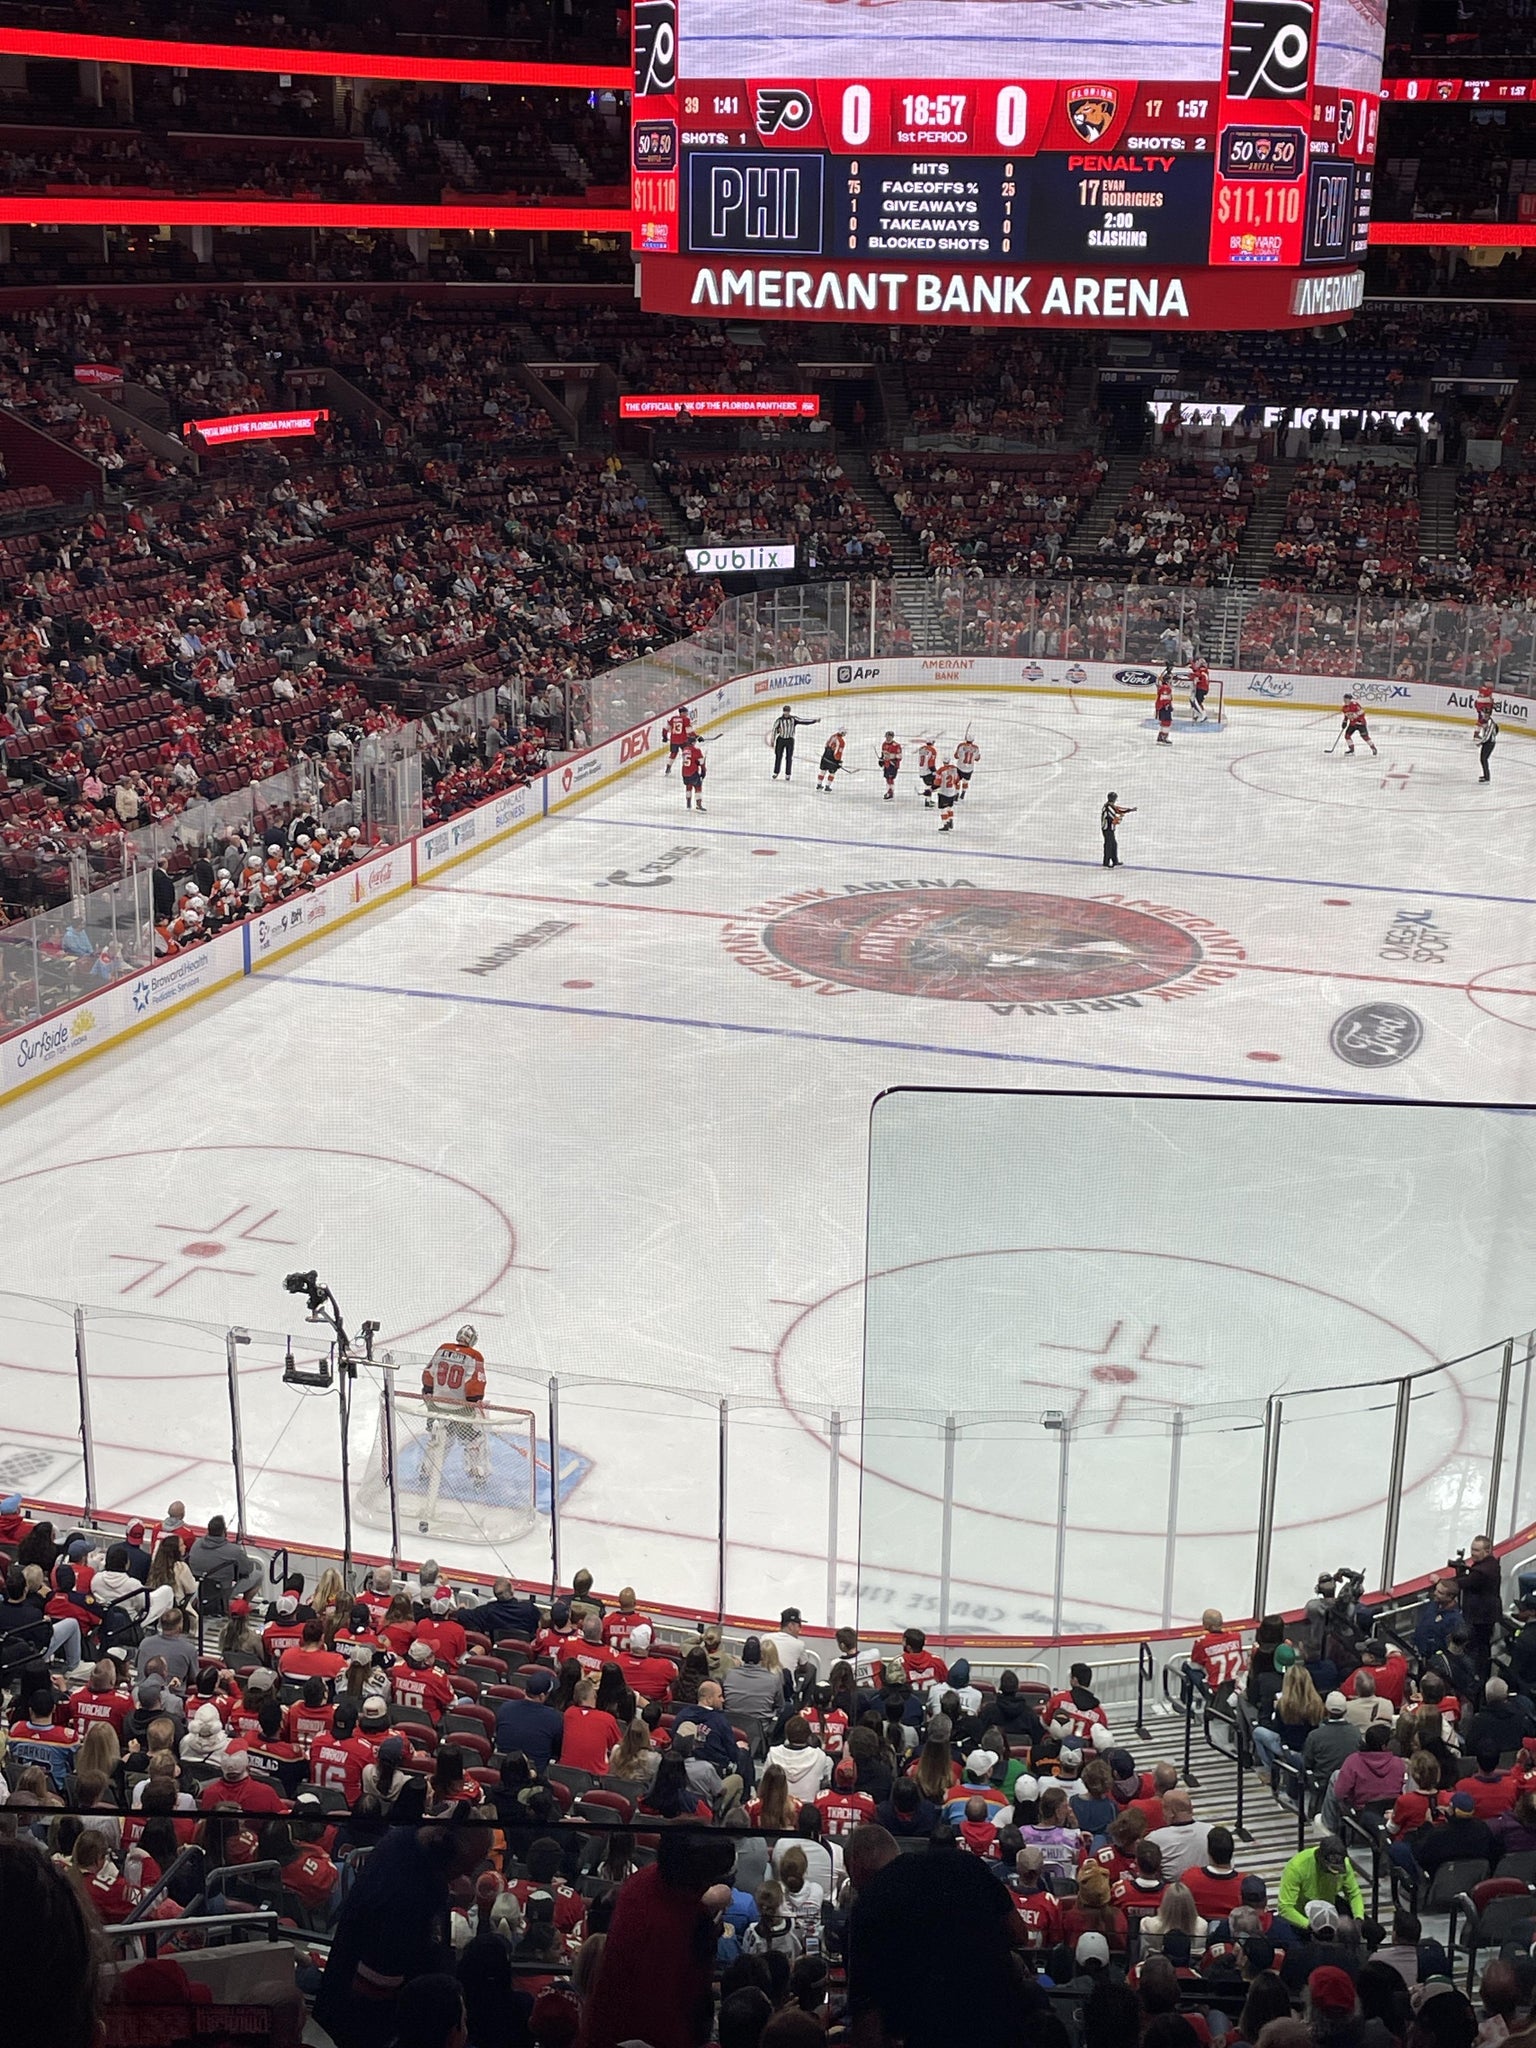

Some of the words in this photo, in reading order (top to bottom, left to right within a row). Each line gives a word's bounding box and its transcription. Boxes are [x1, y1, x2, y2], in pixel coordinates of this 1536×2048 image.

[1407, 81, 1418, 99] 0
[1472, 88, 1480, 100] 2
[685, 98, 700, 114] 39
[713, 97, 739, 115] 1:41
[841, 84, 871, 146] 0
[902, 94, 968, 126] 18:57
[1145, 100, 1162, 118] 17
[1176, 99, 1208, 118] 1:57
[995, 85, 1028, 147] 0
[638, 135, 651, 155] 50
[659, 135, 671, 155] 50
[681, 133, 729, 146] SHOTS:
[739, 134, 747, 146] 1
[897, 131, 915, 143] 1st
[917, 132, 968, 144] PERIOD
[1127, 136, 1186, 150] SHOTS:
[1194, 137, 1207, 150] 2
[1230, 141, 1253, 162] 50
[1272, 142, 1295, 162] 50
[851, 161, 859, 176] 0
[912, 162, 950, 176] HITS
[1004, 162, 1014, 179] 0
[1067, 155, 1176, 173] PENALTY
[848, 180, 861, 195] 75
[882, 181, 964, 195] FACEOFFS
[967, 182, 980, 195] %
[1001, 181, 1016, 198] 25
[1078, 180, 1100, 207] 17
[1102, 180, 1126, 192] EVAN
[634, 177, 676, 216] $11,110
[711, 166, 800, 240] PHI
[1102, 192, 1164, 208] RODRIGUES
[850, 198, 858, 213] 1
[883, 199, 978, 213] GIVEAWAYS
[1004, 200, 1012, 215] 1
[1216, 185, 1300, 227] $11,110
[849, 217, 858, 232] 0
[879, 218, 981, 232] TAKEAWAYS
[1002, 219, 1012, 234] 0
[1104, 212, 1134, 229] 2:00
[849, 235, 858, 250] 0
[868, 236, 936, 250] BLOCKED
[938, 237, 991, 251] SHOTS
[1001, 239, 1011, 253] 0
[1088, 230, 1148, 248] SLASHING
[690, 267, 909, 311] AMERANT
[916, 273, 1033, 315] BANK
[1041, 276, 1190, 318] ARENA
[625, 402, 640, 411] THE
[641, 402, 674, 412] OFFICIAL
[695, 401, 705, 411] OF
[705, 401, 720, 411] THE
[722, 401, 755, 411] FLORIDA
[756, 400, 797, 411] PANTHERS
[697, 548, 779, 572] Publix
[922, 659, 975, 669] AMERANT
[769, 673, 812, 690] AMAZING
[935, 672, 960, 680] BANK
[1119, 671, 1151, 685] Ford
[1352, 682, 1391, 693] OMEGA
[1391, 685, 1411, 698] XL
[1352, 691, 1391, 703] SPORT
[1447, 692, 1529, 718] Autation
[619, 727, 652, 765] DEX
[842, 877, 979, 896] ARENA
[986, 994, 1144, 1017] ARENA
[1342, 1013, 1409, 1058] Ford
[17, 1022, 69, 1068] Surfside
[906, 1593, 1006, 1623] CRUSE
[1210, 1651, 1242, 1686] 72
[314, 1762, 347, 1790] 16
